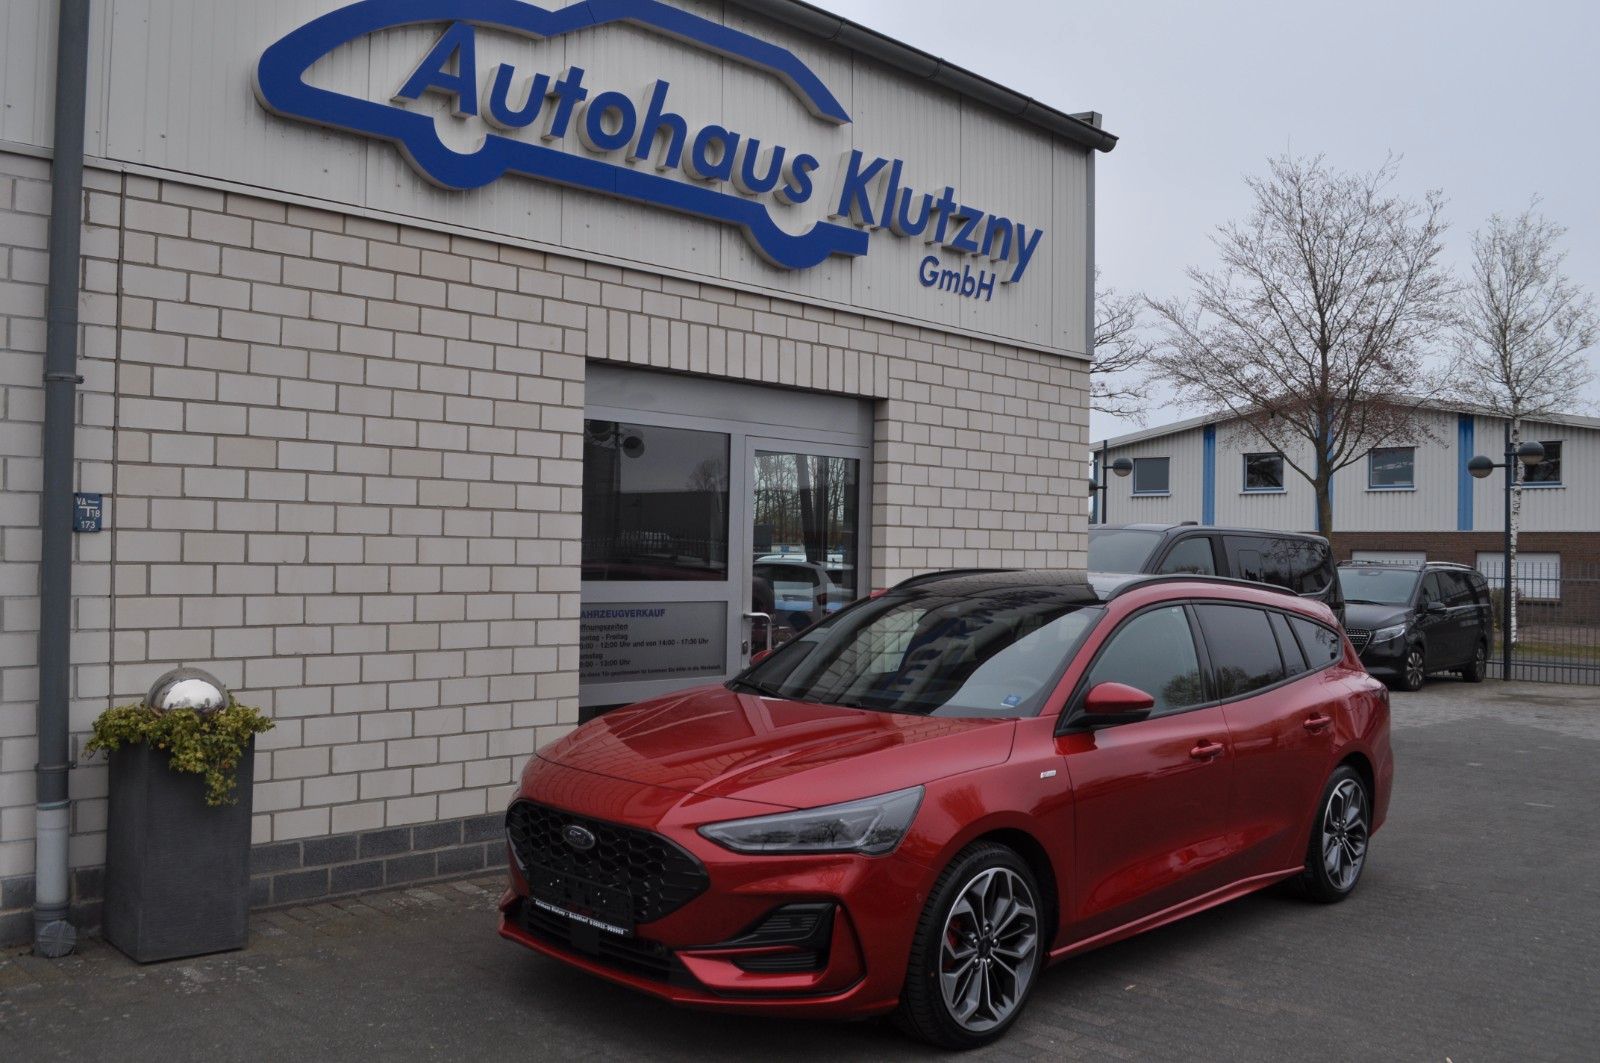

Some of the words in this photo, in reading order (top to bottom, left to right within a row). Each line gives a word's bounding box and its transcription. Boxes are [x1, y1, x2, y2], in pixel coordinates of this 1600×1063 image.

[394, 20, 821, 204] Autohaus
[836, 149, 1043, 283] Klutzny
[919, 255, 996, 301] GmbH
[80, 520, 96, 529] 173
[580, 608, 666, 619] AHRZEUGVERKAUF
[580, 623, 629, 632] ffnungszeiten
[580, 634, 600, 642] ontag
